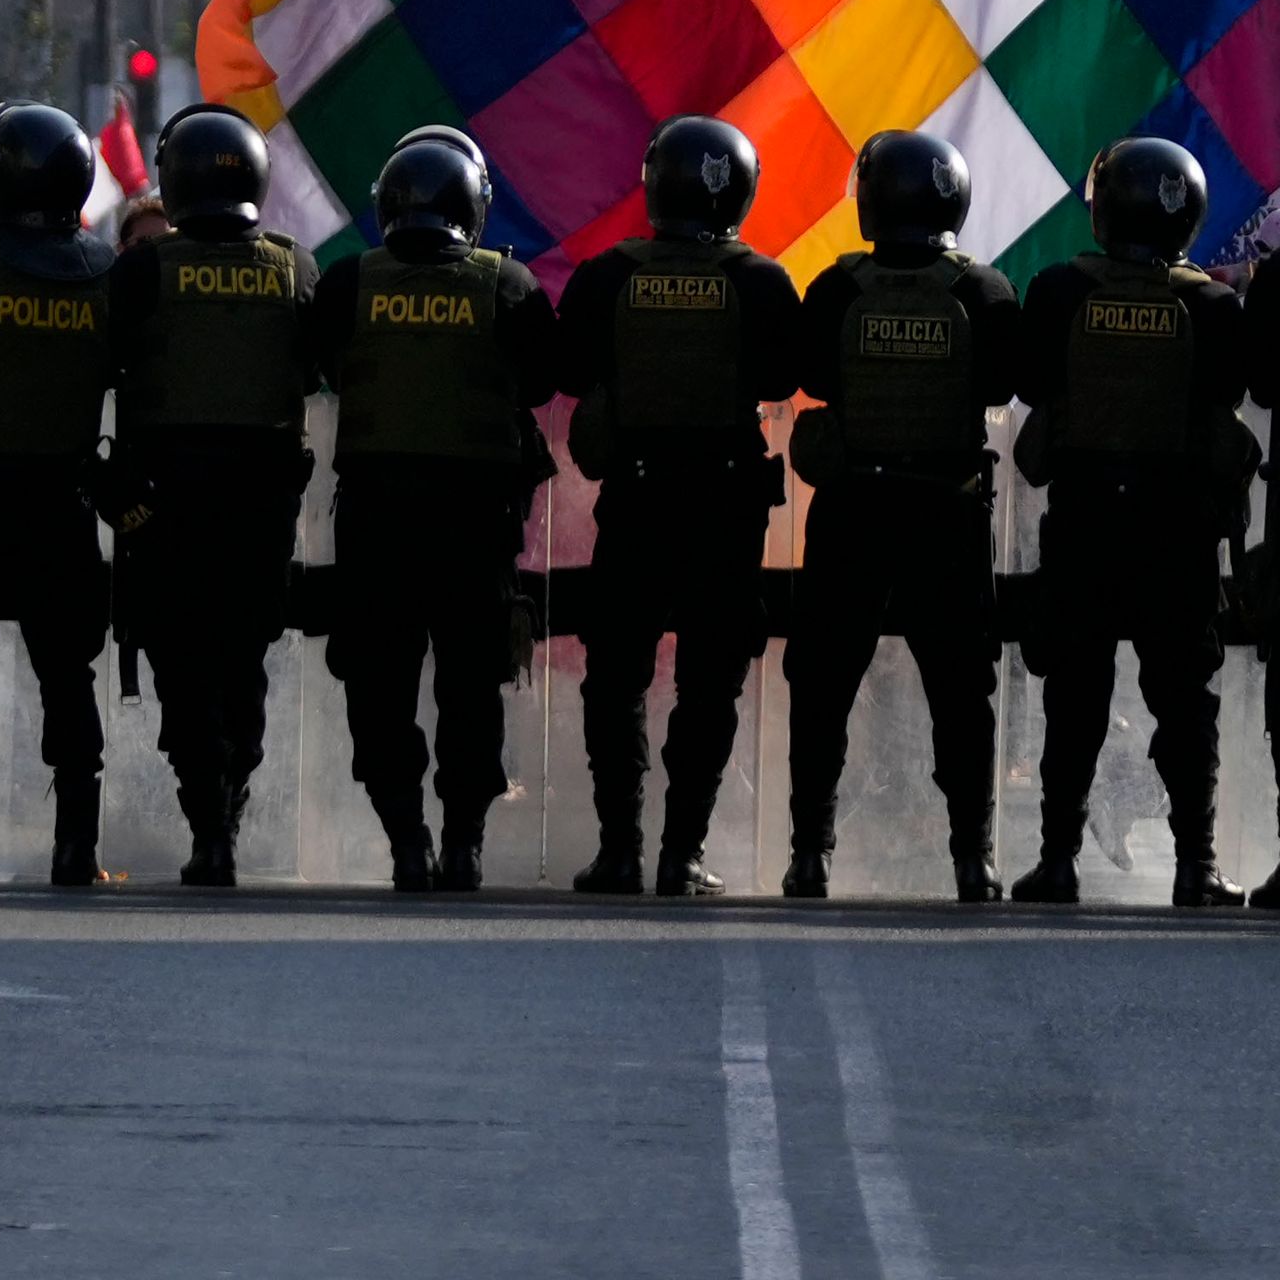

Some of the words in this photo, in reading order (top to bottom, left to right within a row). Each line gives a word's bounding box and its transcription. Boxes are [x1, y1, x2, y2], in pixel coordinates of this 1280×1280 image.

[178, 265, 281, 296] POLICIA
[636, 278, 721, 295] POLICIA
[371, 295, 474, 325] POLICIA
[1090, 304, 1174, 333] POLICIA
[866, 319, 945, 341] POLICIA
